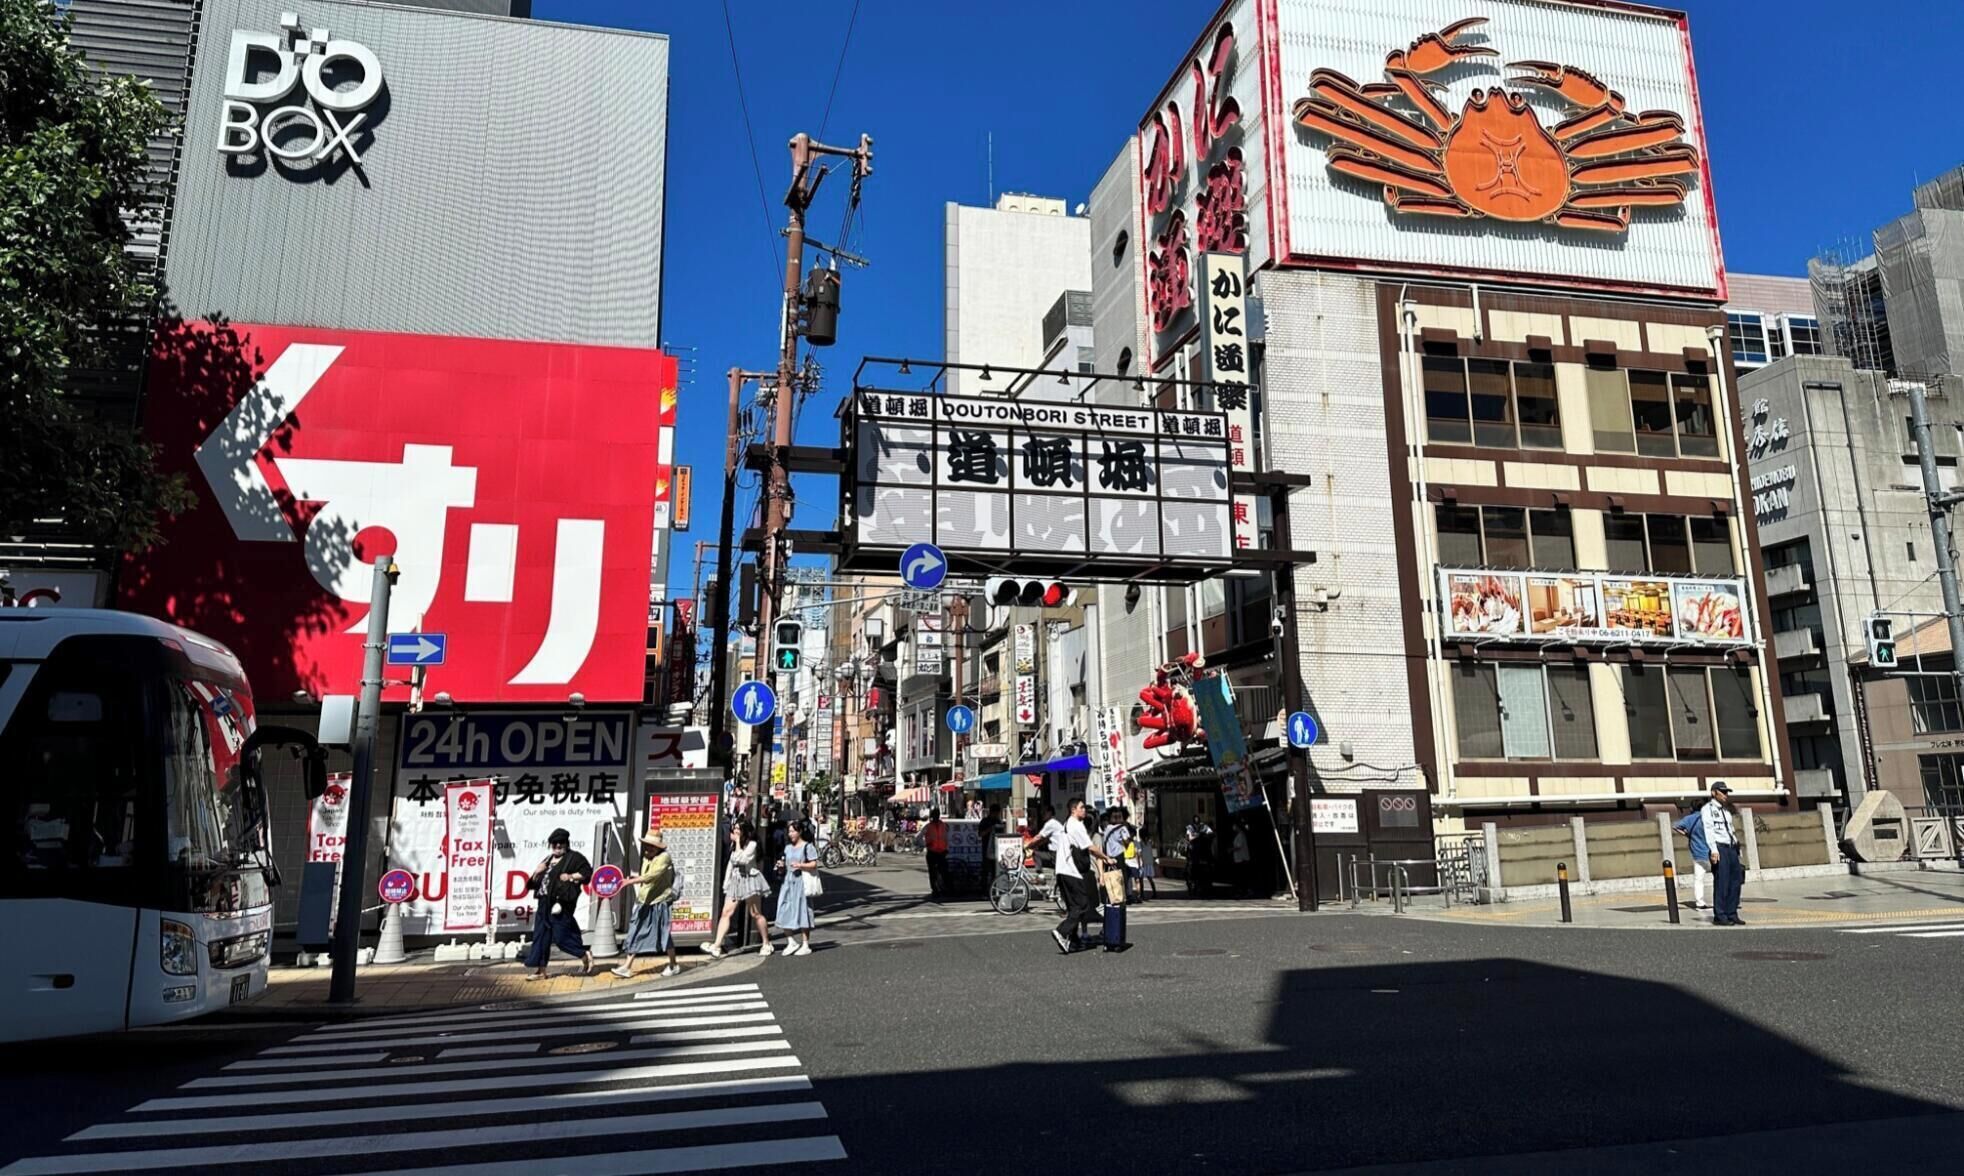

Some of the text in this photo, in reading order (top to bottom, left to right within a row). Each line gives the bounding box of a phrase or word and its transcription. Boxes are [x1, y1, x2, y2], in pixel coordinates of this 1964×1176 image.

[1145, 22, 1243, 215] かに
[217, 102, 368, 165] BOX
[862, 395, 928, 418] 道頓堀
[942, 402, 1149, 430] DOUTONBORI STREET
[1162, 415, 1222, 437] 道頓堀
[947, 432, 1148, 491] 道頓堀
[408, 719, 624, 763] 24h OPEN
[406, 772, 619, 807] 本免税店
[523, 808, 538, 816] Our
[540, 808, 557, 818] shop
[567, 808, 584, 818] duty
[586, 807, 601, 815] free
[316, 833, 348, 847] Tax
[454, 838, 483, 852] Tax
[313, 850, 343, 862] Fre
[451, 854, 485, 868] Free
